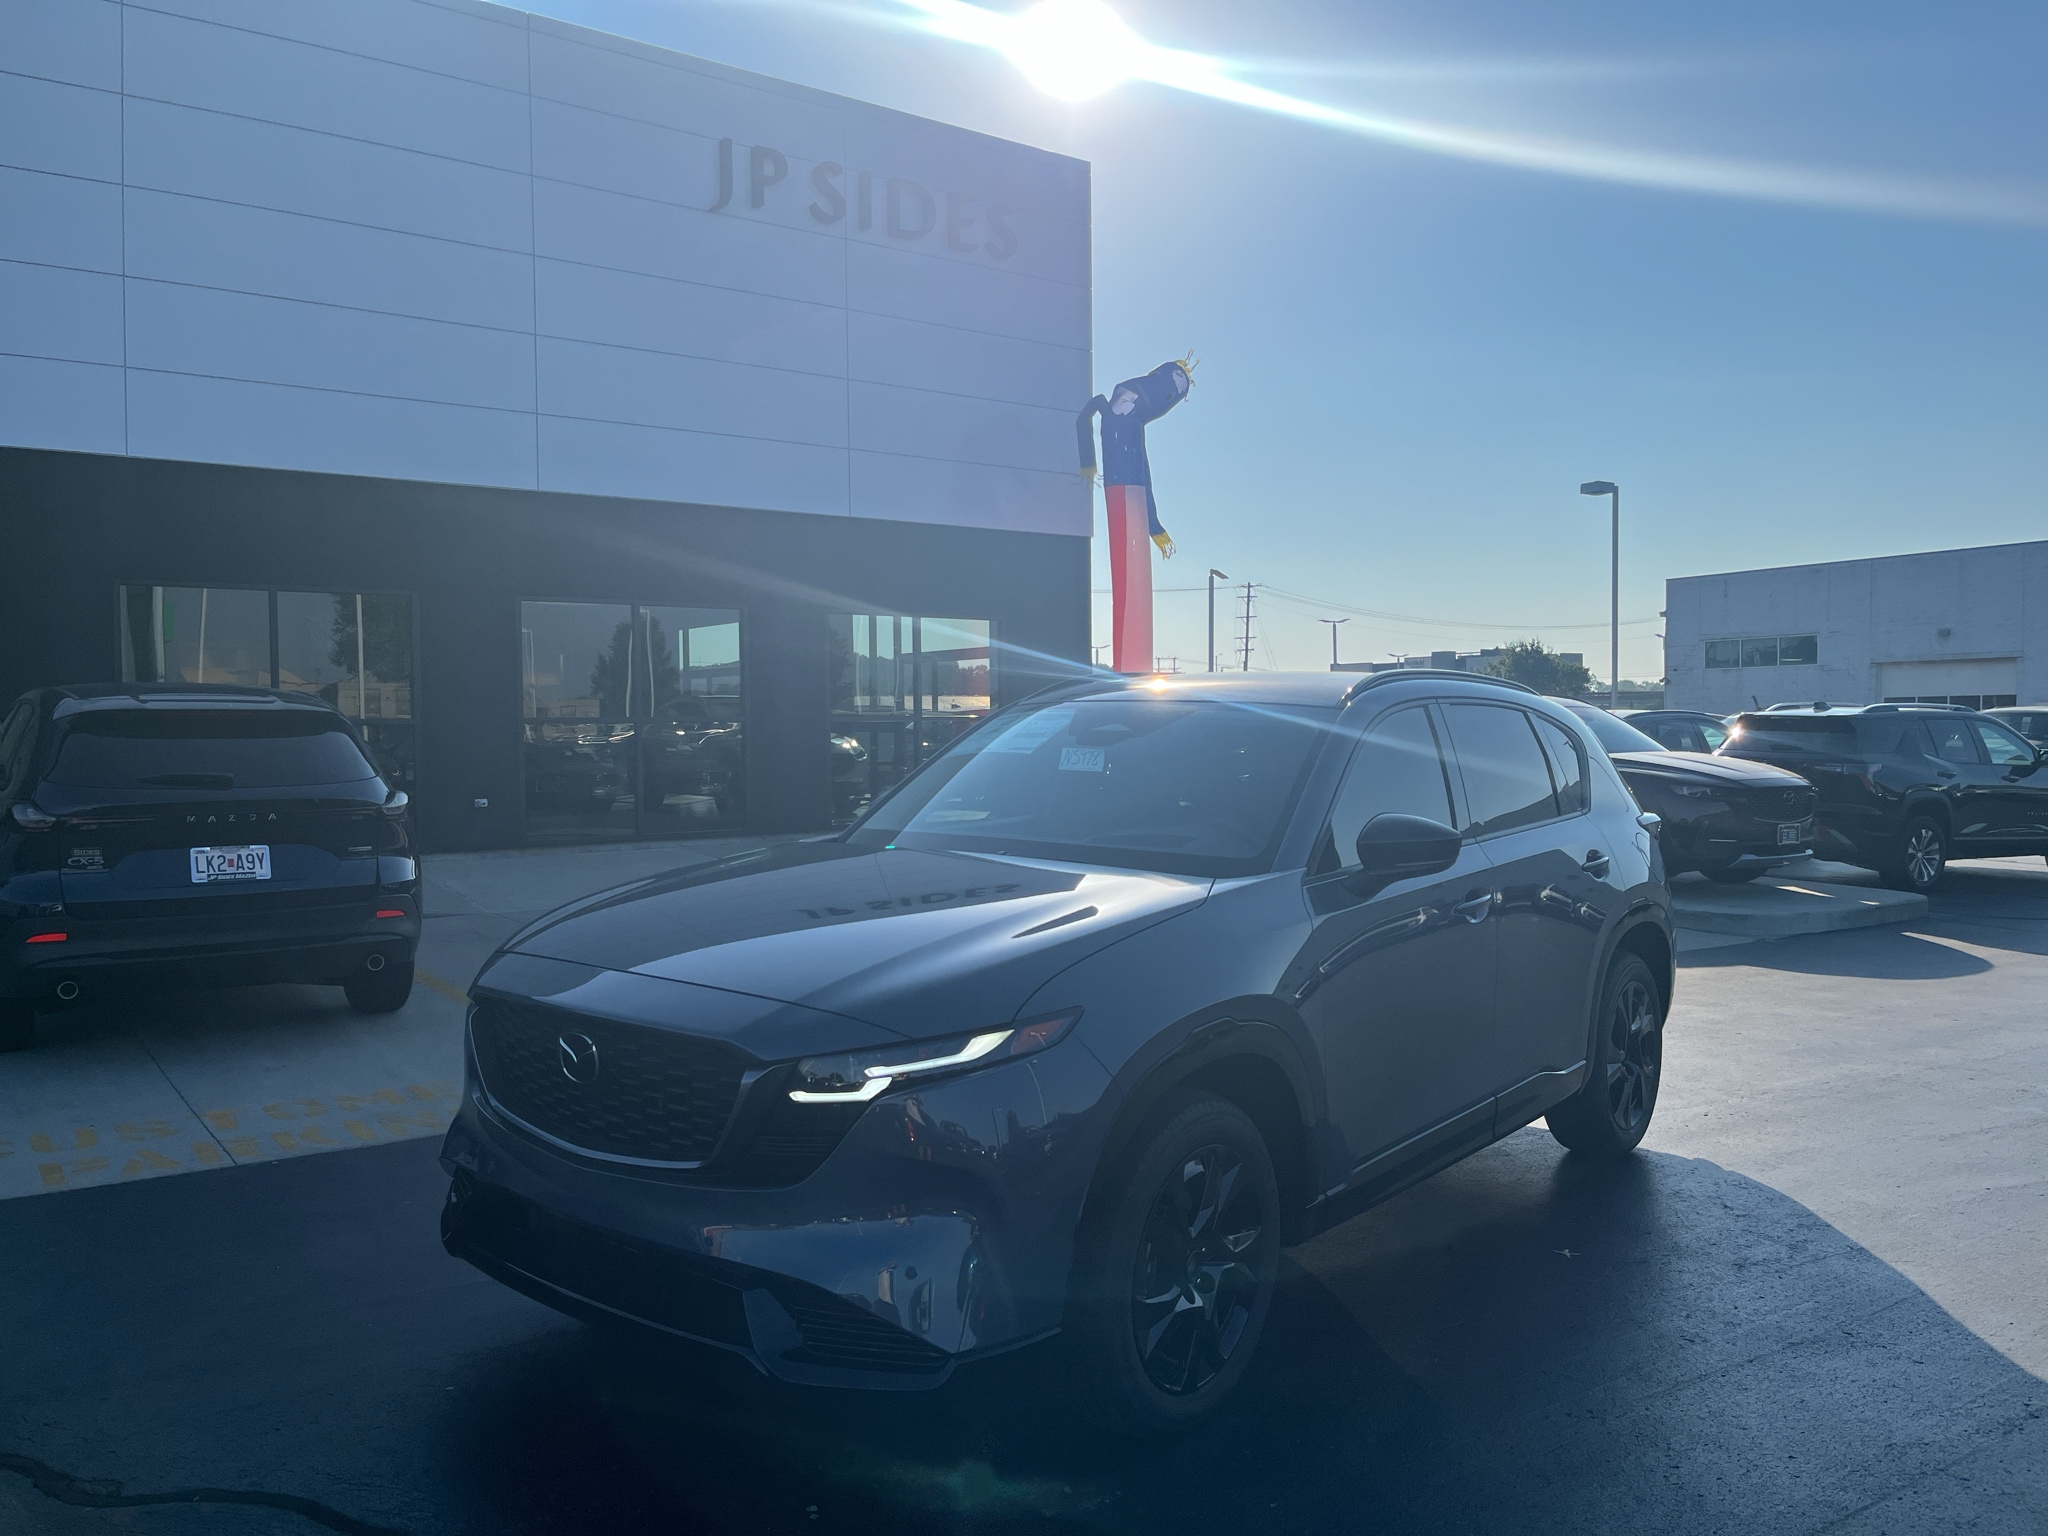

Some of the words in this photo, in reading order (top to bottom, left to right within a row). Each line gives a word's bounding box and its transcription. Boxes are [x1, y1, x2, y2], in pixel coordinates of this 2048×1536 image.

[708, 137, 788, 213] JP
[809, 161, 1018, 260] SIDES
[186, 813, 277, 823] MAZDA
[67, 856, 104, 866] CX-5
[194, 854, 227, 874] LK2
[236, 852, 265, 871] A9Y
[0, 1078, 462, 1160] USTOME
[38, 1107, 460, 1188] PARKIN
